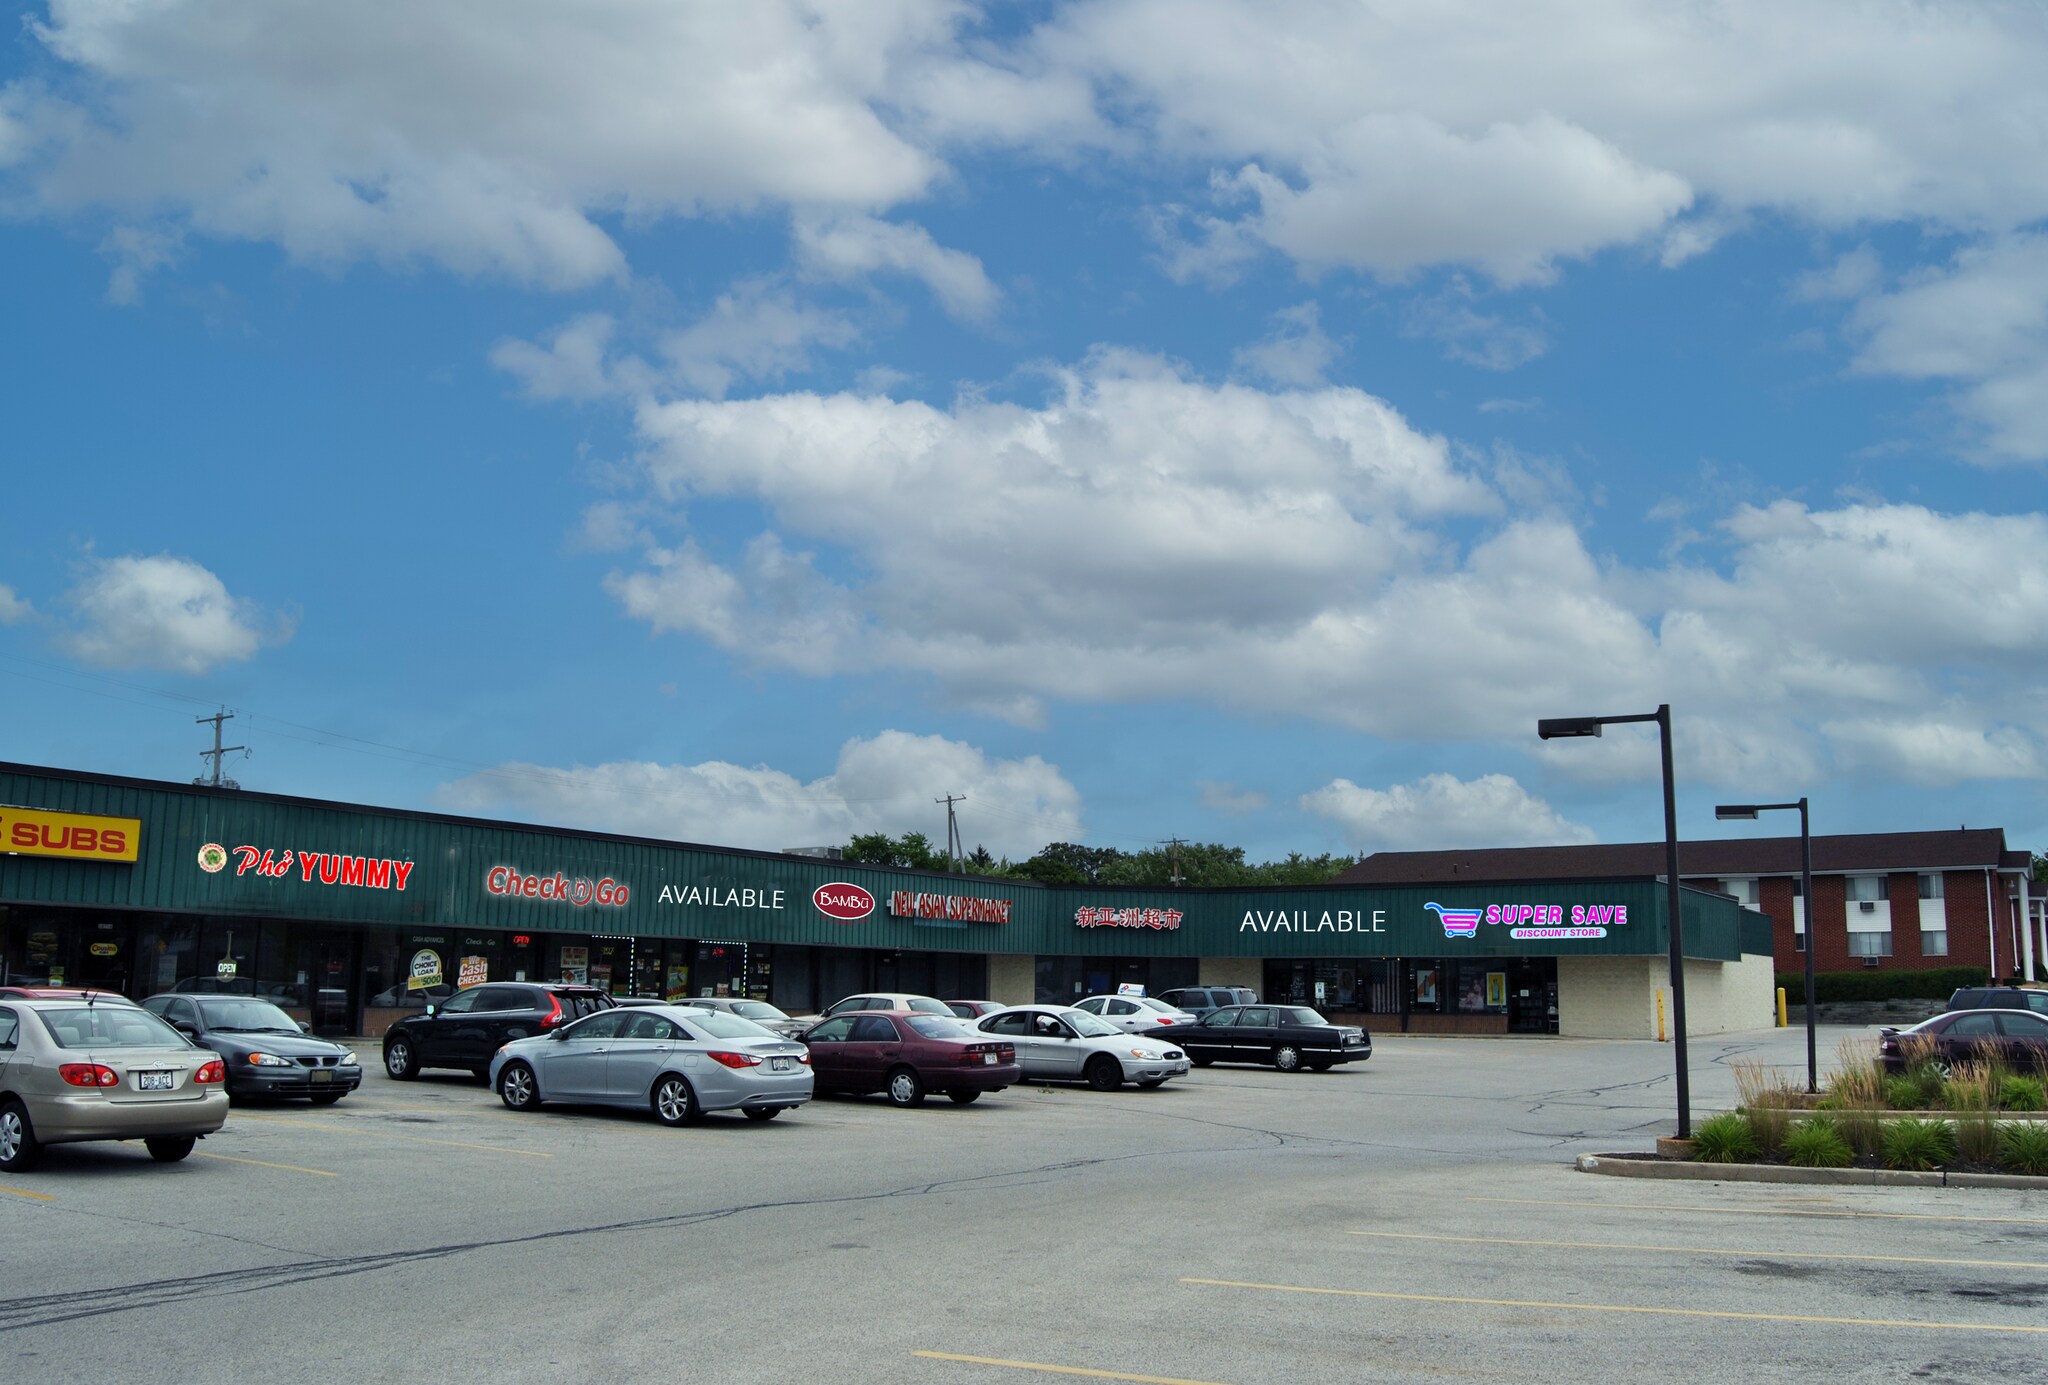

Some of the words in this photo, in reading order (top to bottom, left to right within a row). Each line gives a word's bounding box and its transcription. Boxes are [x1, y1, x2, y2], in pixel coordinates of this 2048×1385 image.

[11, 822, 126, 853] SUBS
[299, 851, 415, 890] YUMMY
[487, 865, 570, 900] Check
[596, 877, 629, 906] Go
[657, 884, 785, 909] AVAILABLE
[890, 890, 915, 917] NEW
[916, 893, 947, 919] ASIAN
[946, 895, 1012, 923] SUPERMARKET
[1076, 906, 1183, 930] 新亚洲超市
[1239, 910, 1386, 932] AVAILABLE
[1486, 904, 1563, 925] SUPER
[1571, 905, 1627, 925] SAVE
[1516, 928, 1567, 938] DISCOUNT
[1569, 928, 1601, 937] STORE
[217, 963, 237, 973] OPEN
[414, 960, 437, 970] CHOICE
[417, 968, 434, 976] LOAN
[460, 961, 488, 977] Cash
[457, 974, 487, 987] CHECKS
